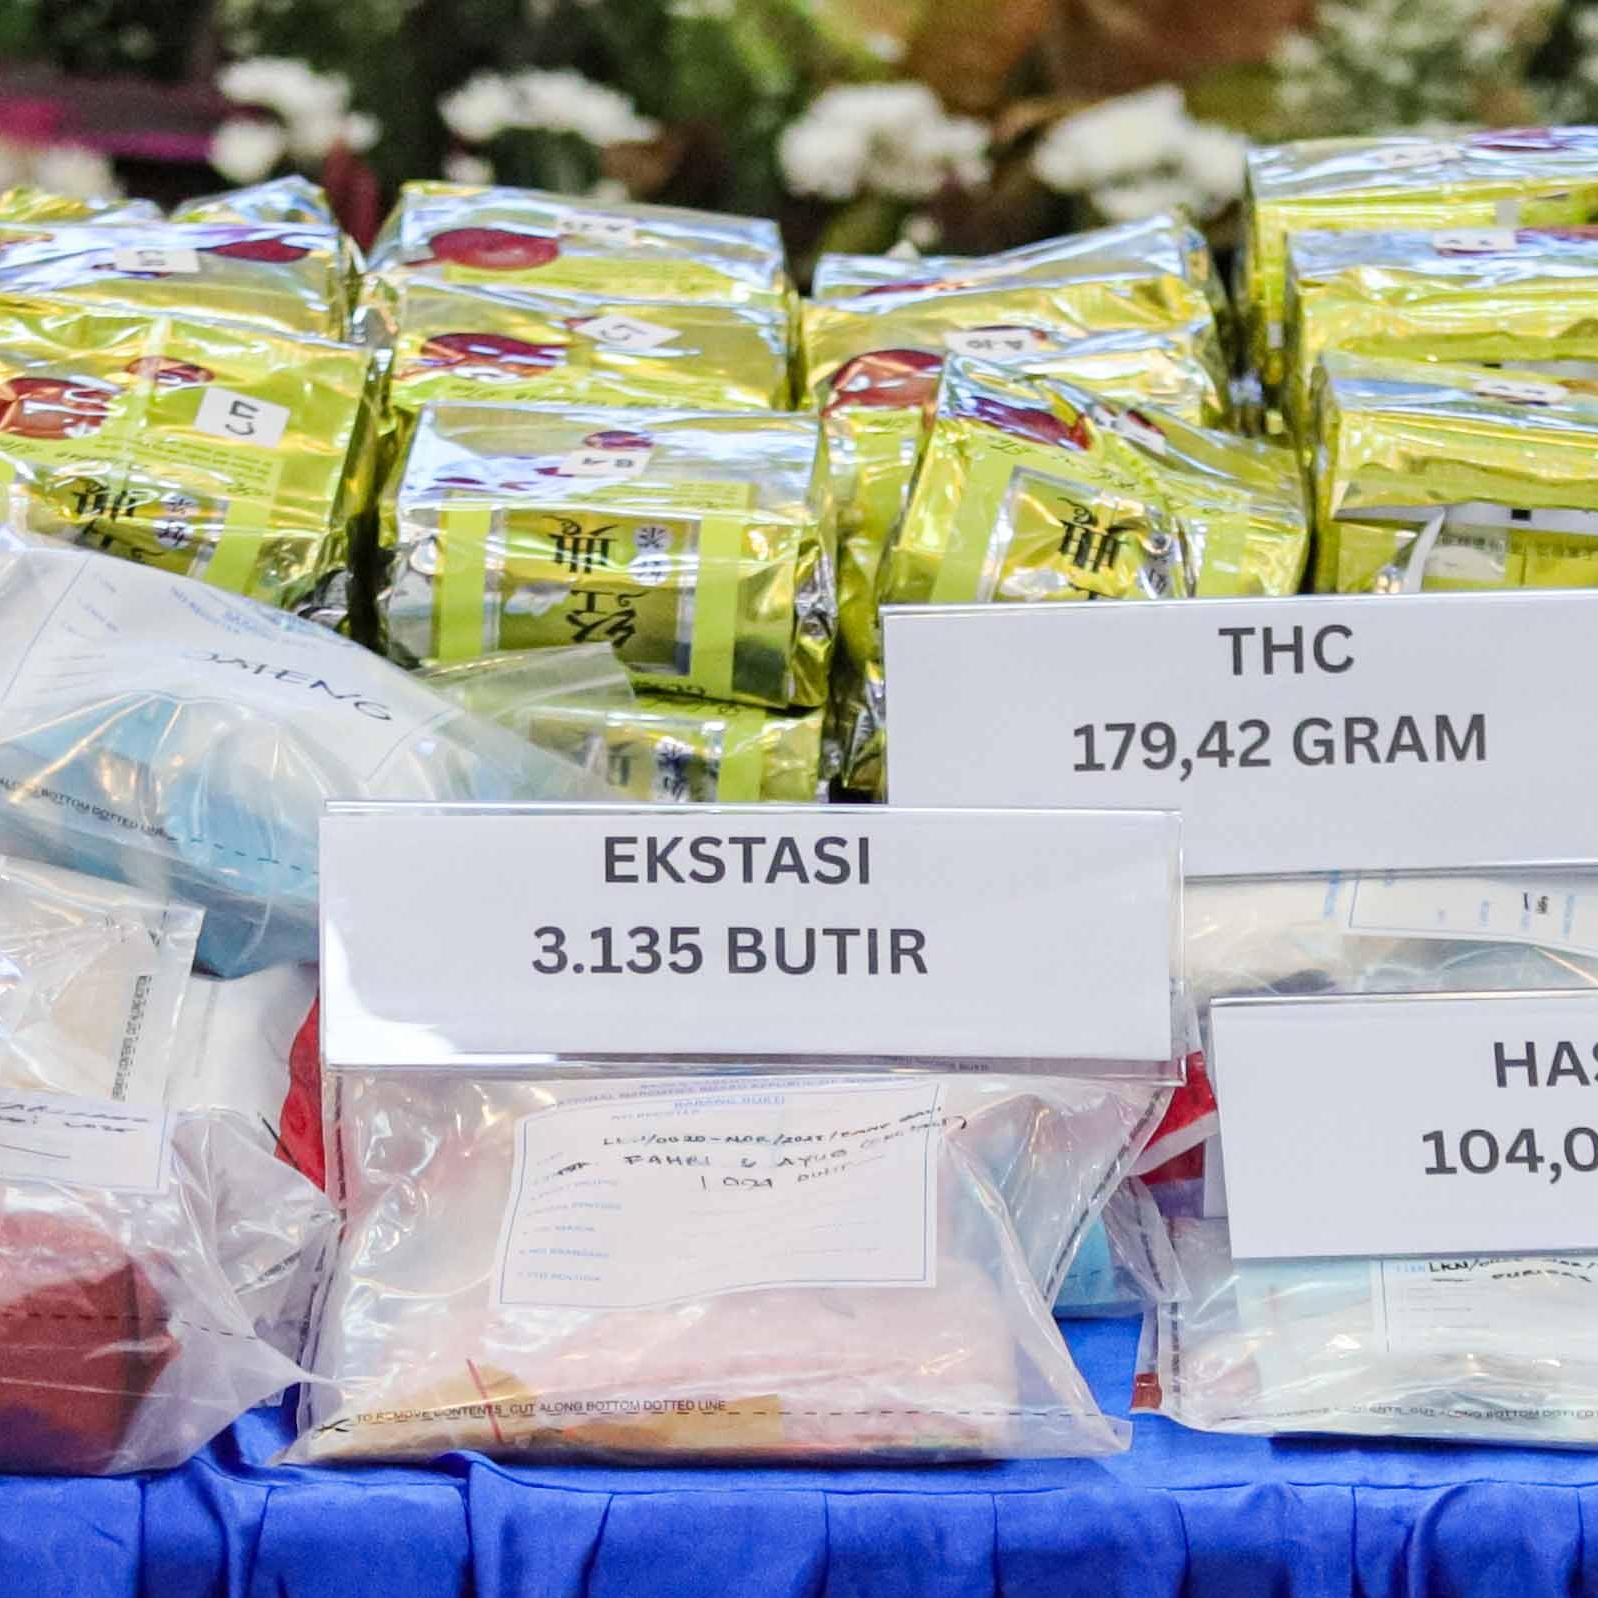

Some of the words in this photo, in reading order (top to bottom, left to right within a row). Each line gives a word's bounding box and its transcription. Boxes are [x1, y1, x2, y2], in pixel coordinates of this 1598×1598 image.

[1218, 624, 1355, 676] THC
[1072, 718, 1271, 782] 179,42
[1291, 713, 1488, 766] GRAM
[604, 836, 871, 885] EKSTASI
[532, 926, 704, 975] 3.135
[727, 926, 929, 975] BUTIR
[375, 1408, 431, 1424] REMOVE
[508, 1401, 536, 1416] CUT
[539, 1400, 584, 1414] ALONG
[585, 1399, 642, 1413] BOTTOM
[642, 1398, 696, 1413] DOTTED
[698, 1398, 728, 1412] LINE
